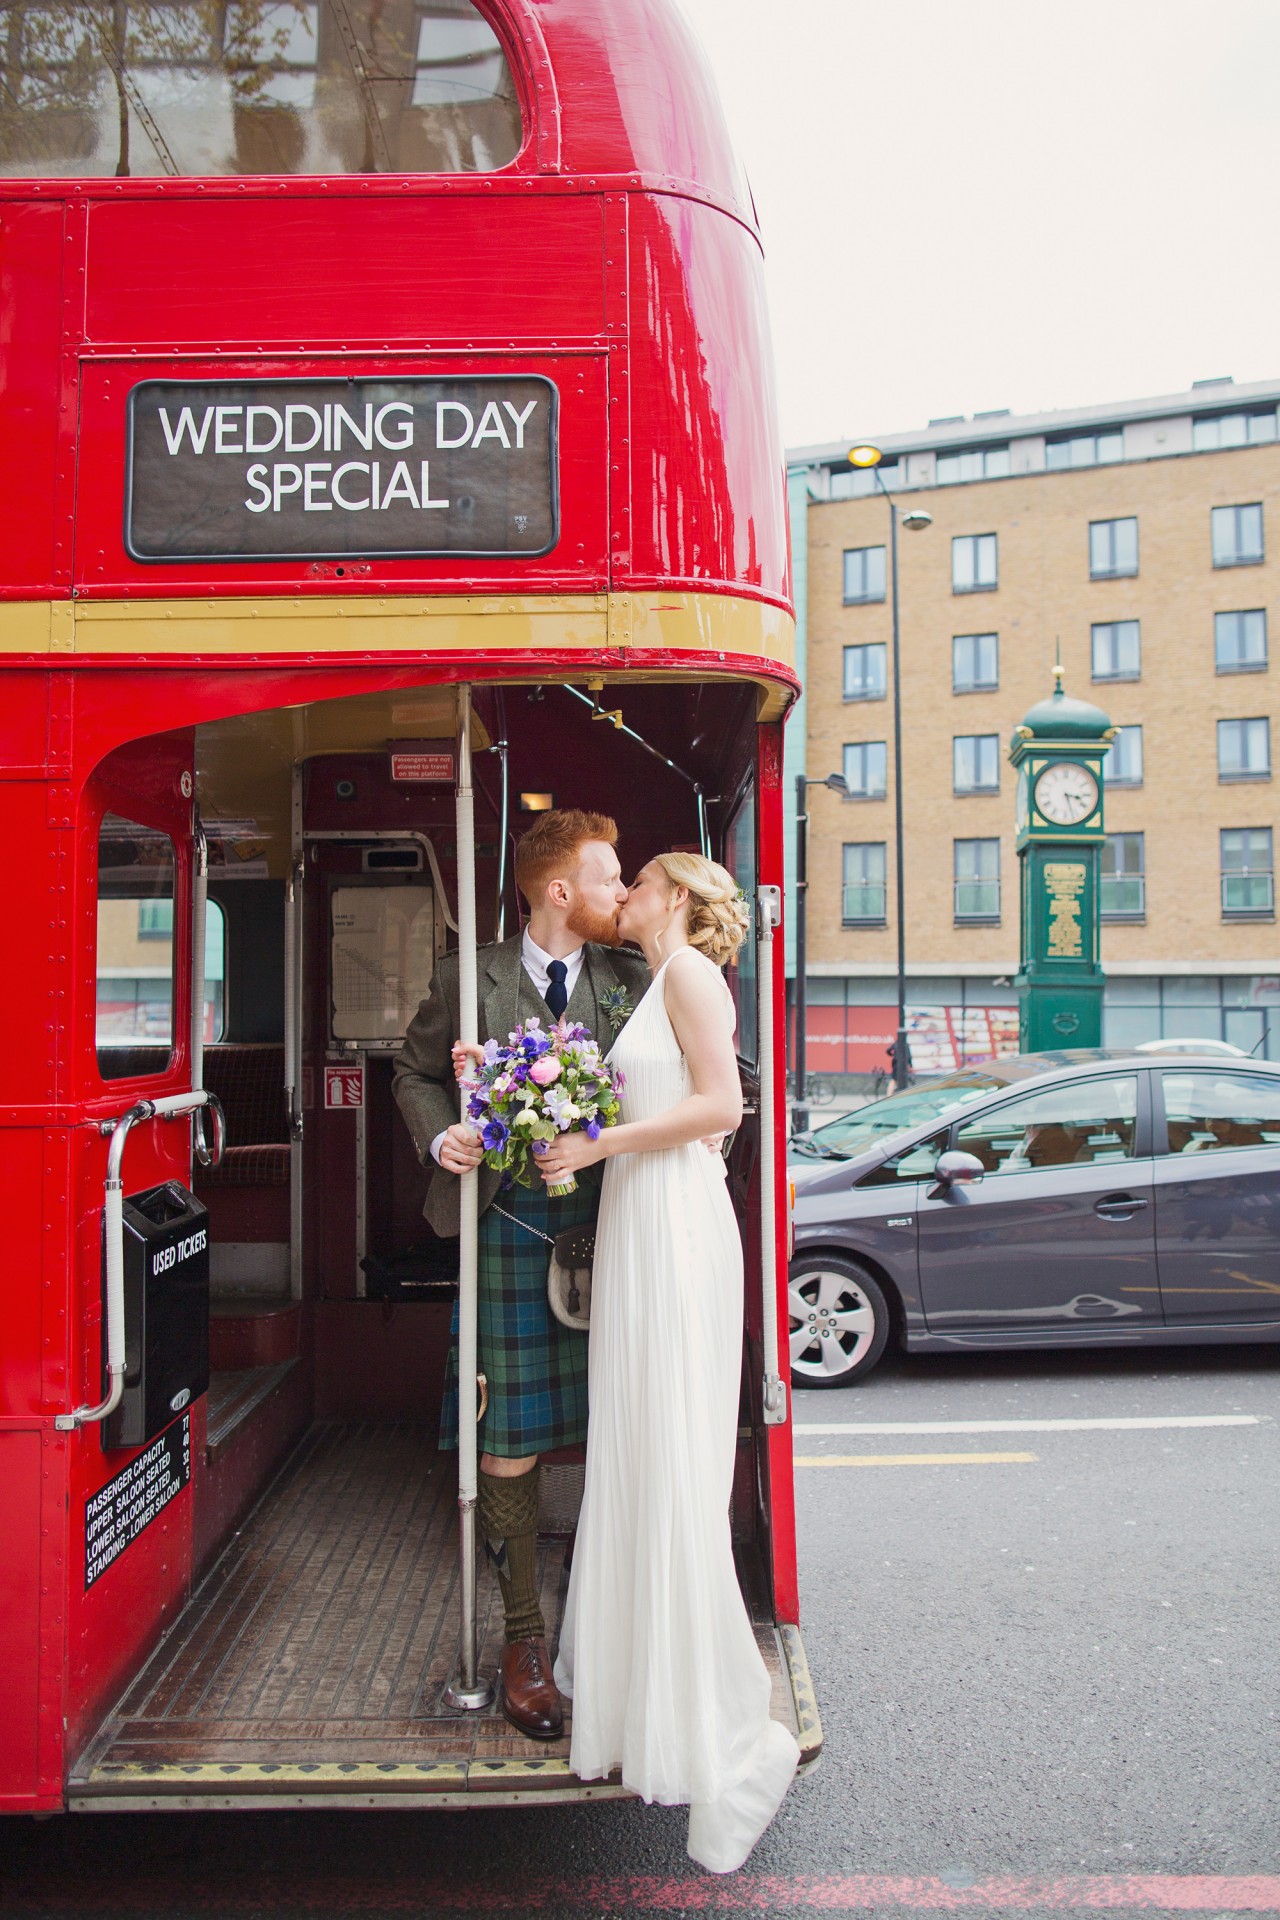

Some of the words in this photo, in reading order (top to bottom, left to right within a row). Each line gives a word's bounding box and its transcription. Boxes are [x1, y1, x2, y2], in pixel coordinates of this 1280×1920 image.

[158, 402, 414, 456] WEDDING
[436, 401, 538, 449] DAY
[244, 460, 450, 513] SPECIAL
[394, 756, 427, 764] Passengers
[420, 770, 448, 778] platform
[153, 1245, 176, 1276] USED
[177, 1229, 207, 1263] TICKETS
[87, 1467, 133, 1521] PASSENGER
[133, 1437, 166, 1476] CAPACITY
[182, 1414, 190, 1431] 77
[87, 1506, 113, 1542] UPPER
[116, 1477, 145, 1514] SALOON
[146, 1451, 171, 1485] SEATED
[87, 1526, 116, 1563] LOWER
[116, 1497, 145, 1535] SALOON
[146, 1469, 171, 1504] SEATED
[182, 1449, 190, 1466] 32
[87, 1535, 126, 1584] STANDING
[130, 1504, 155, 1537] LOWER
[155, 1476, 180, 1513] SALOON
[185, 1465, 190, 1480] 5
